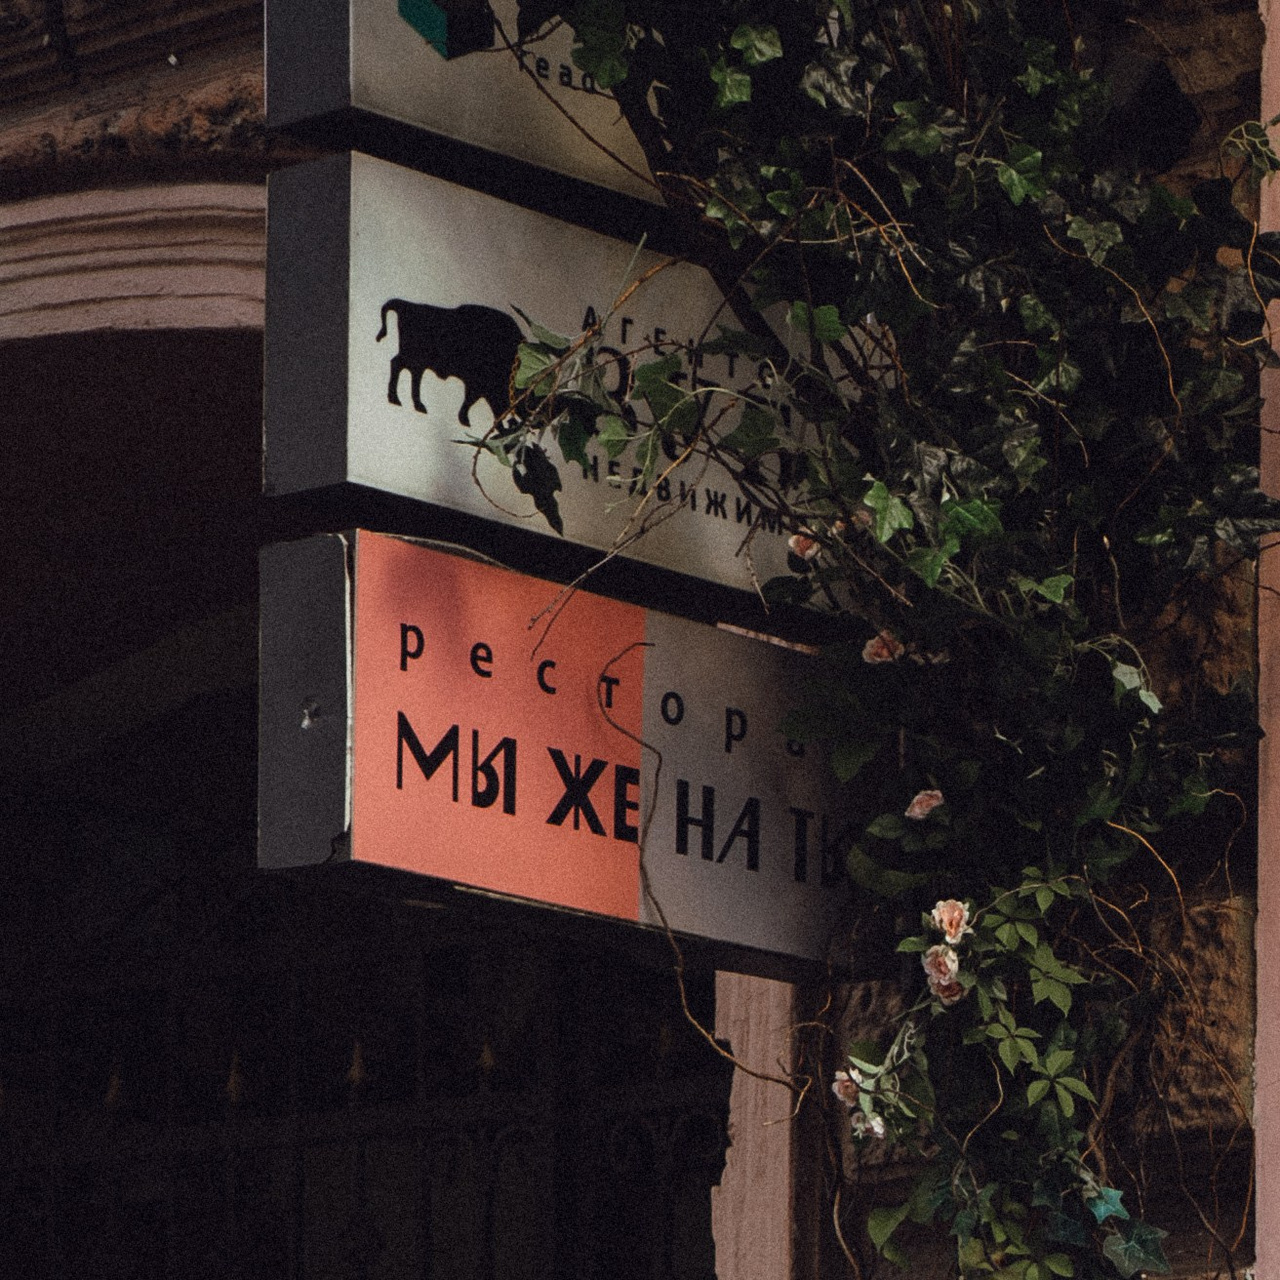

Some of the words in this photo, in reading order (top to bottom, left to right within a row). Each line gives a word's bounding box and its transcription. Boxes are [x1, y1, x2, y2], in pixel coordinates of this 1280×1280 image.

[397, 711, 518, 816] МЫ
[545, 747, 641, 845] ЖЕ
[674, 778, 761, 873] НА
